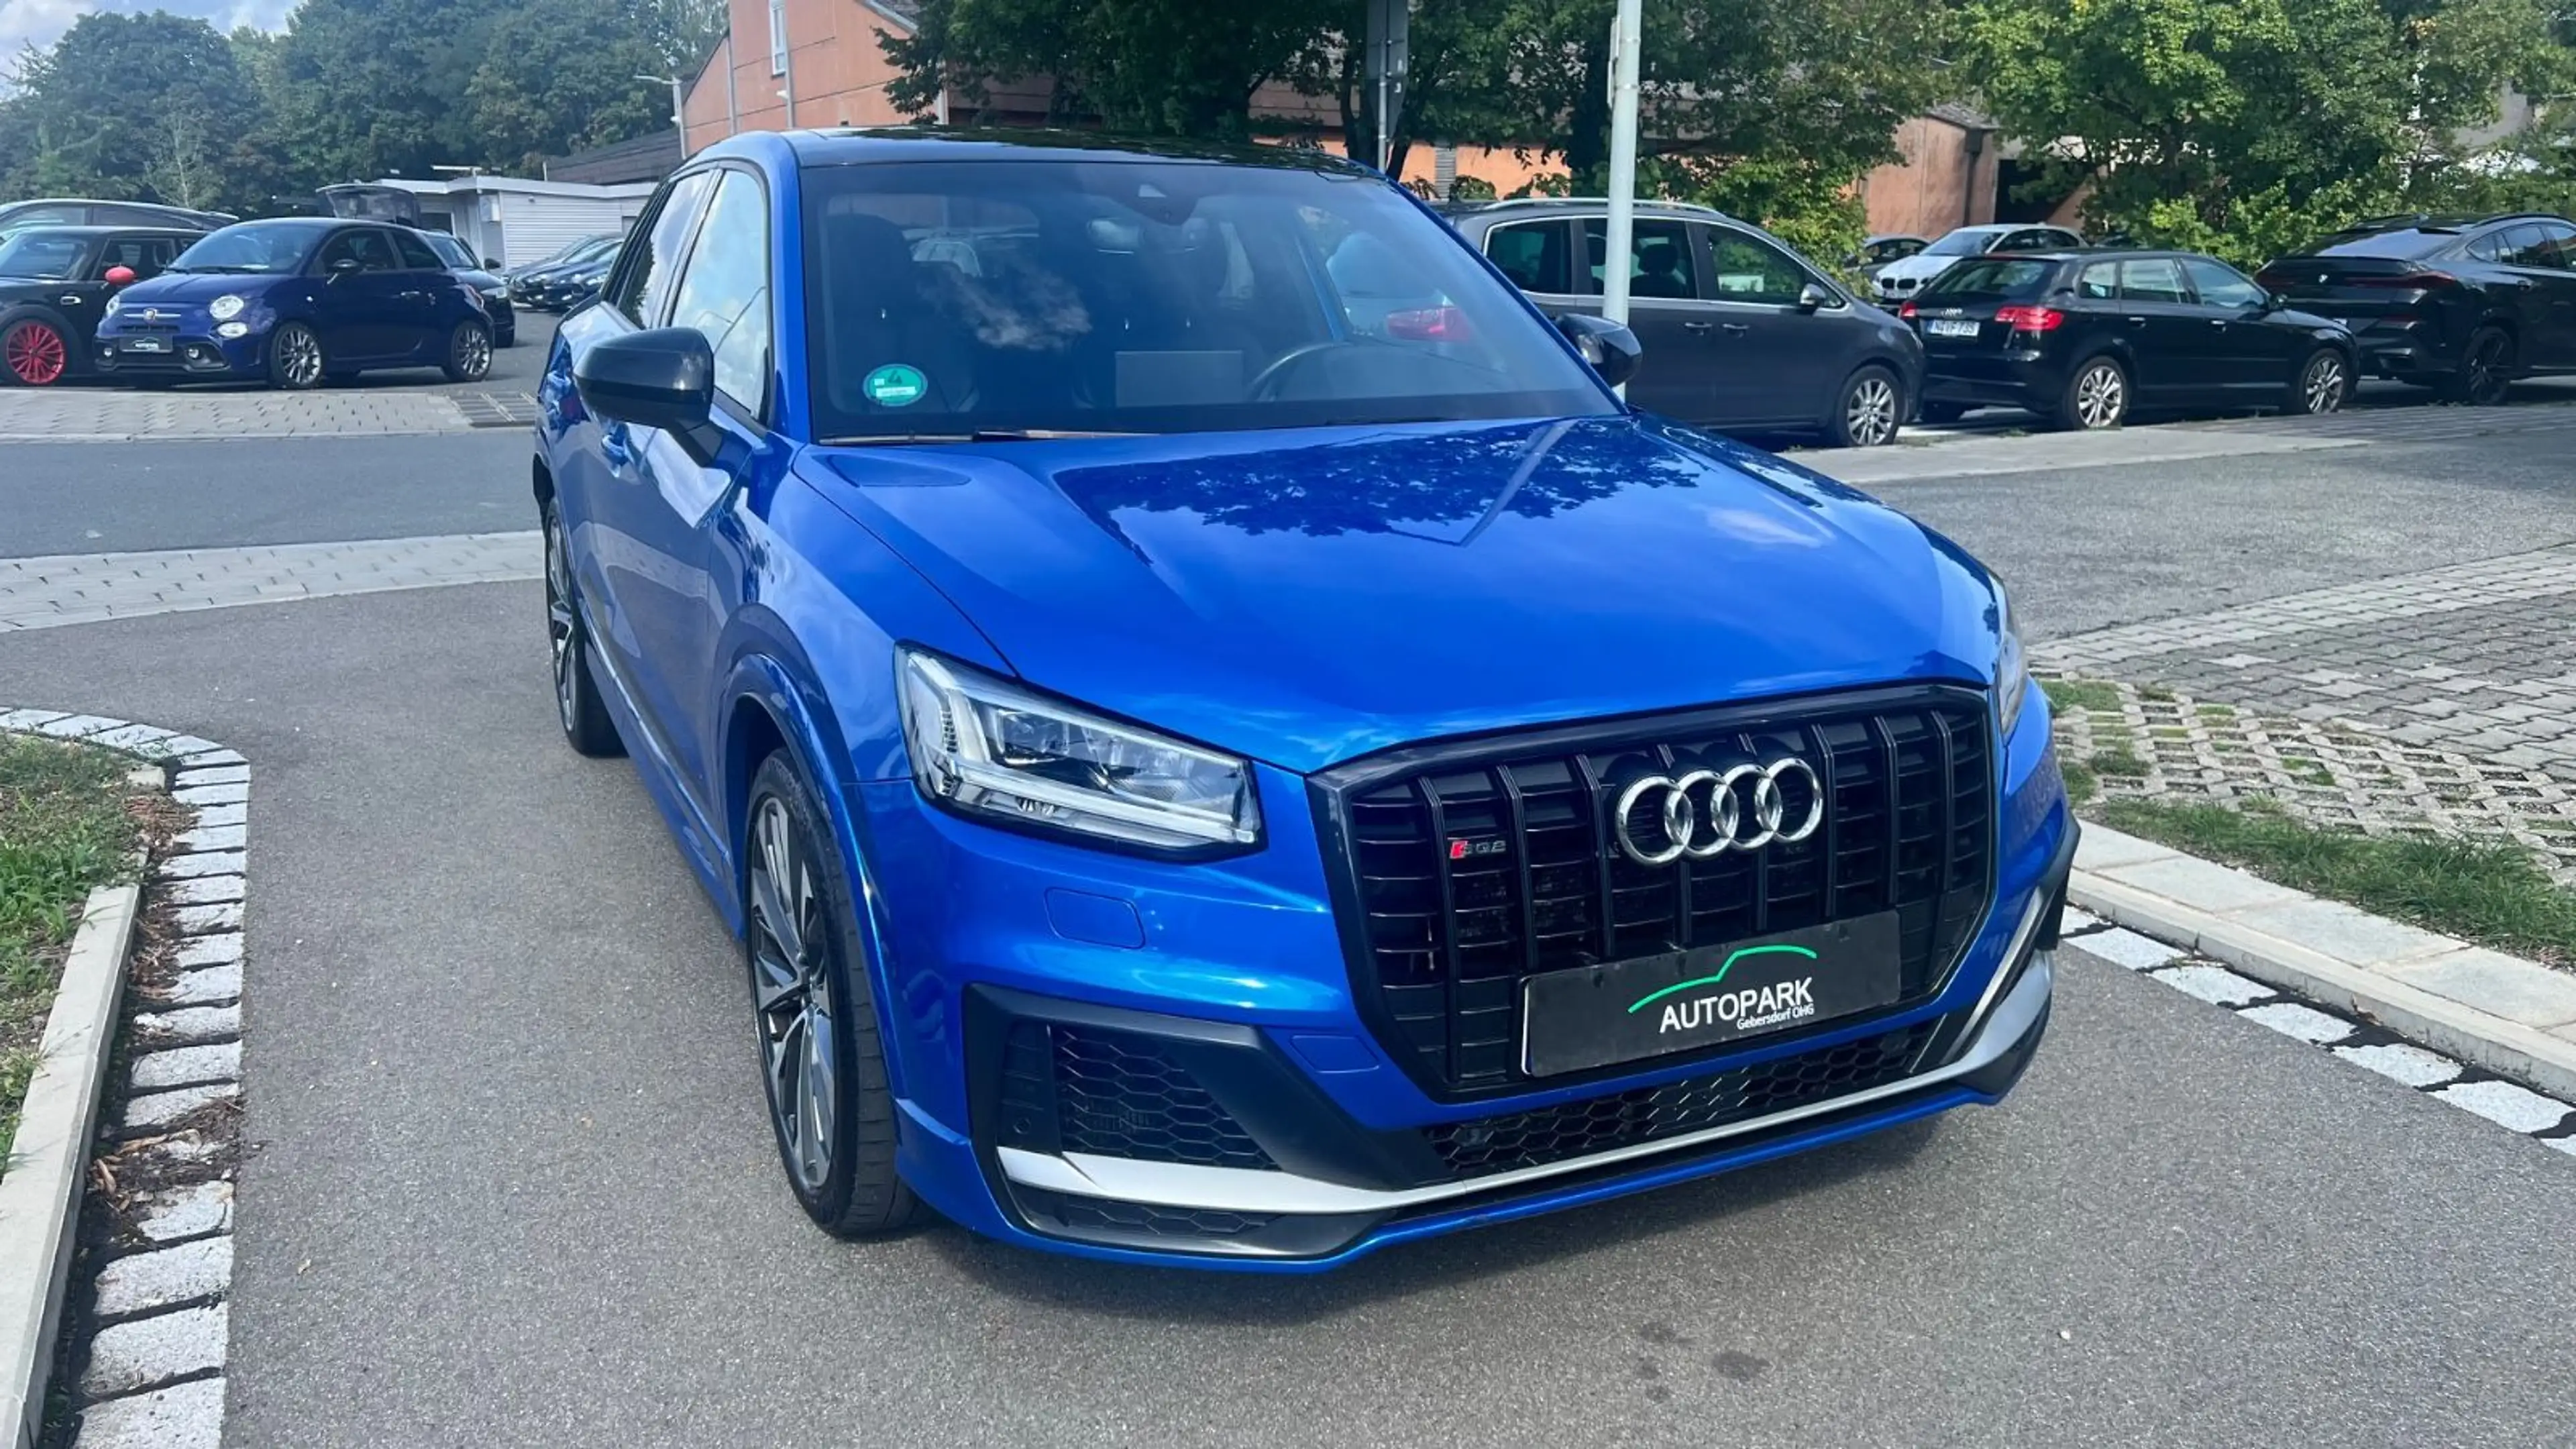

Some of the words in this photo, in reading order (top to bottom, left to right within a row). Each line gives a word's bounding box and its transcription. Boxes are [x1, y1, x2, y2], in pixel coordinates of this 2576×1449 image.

[1660, 977, 1813, 1033] AUTOPARK
[1737, 1008, 1791, 1030] Gebersdorf
[1792, 1004, 1813, 1018] OHG
